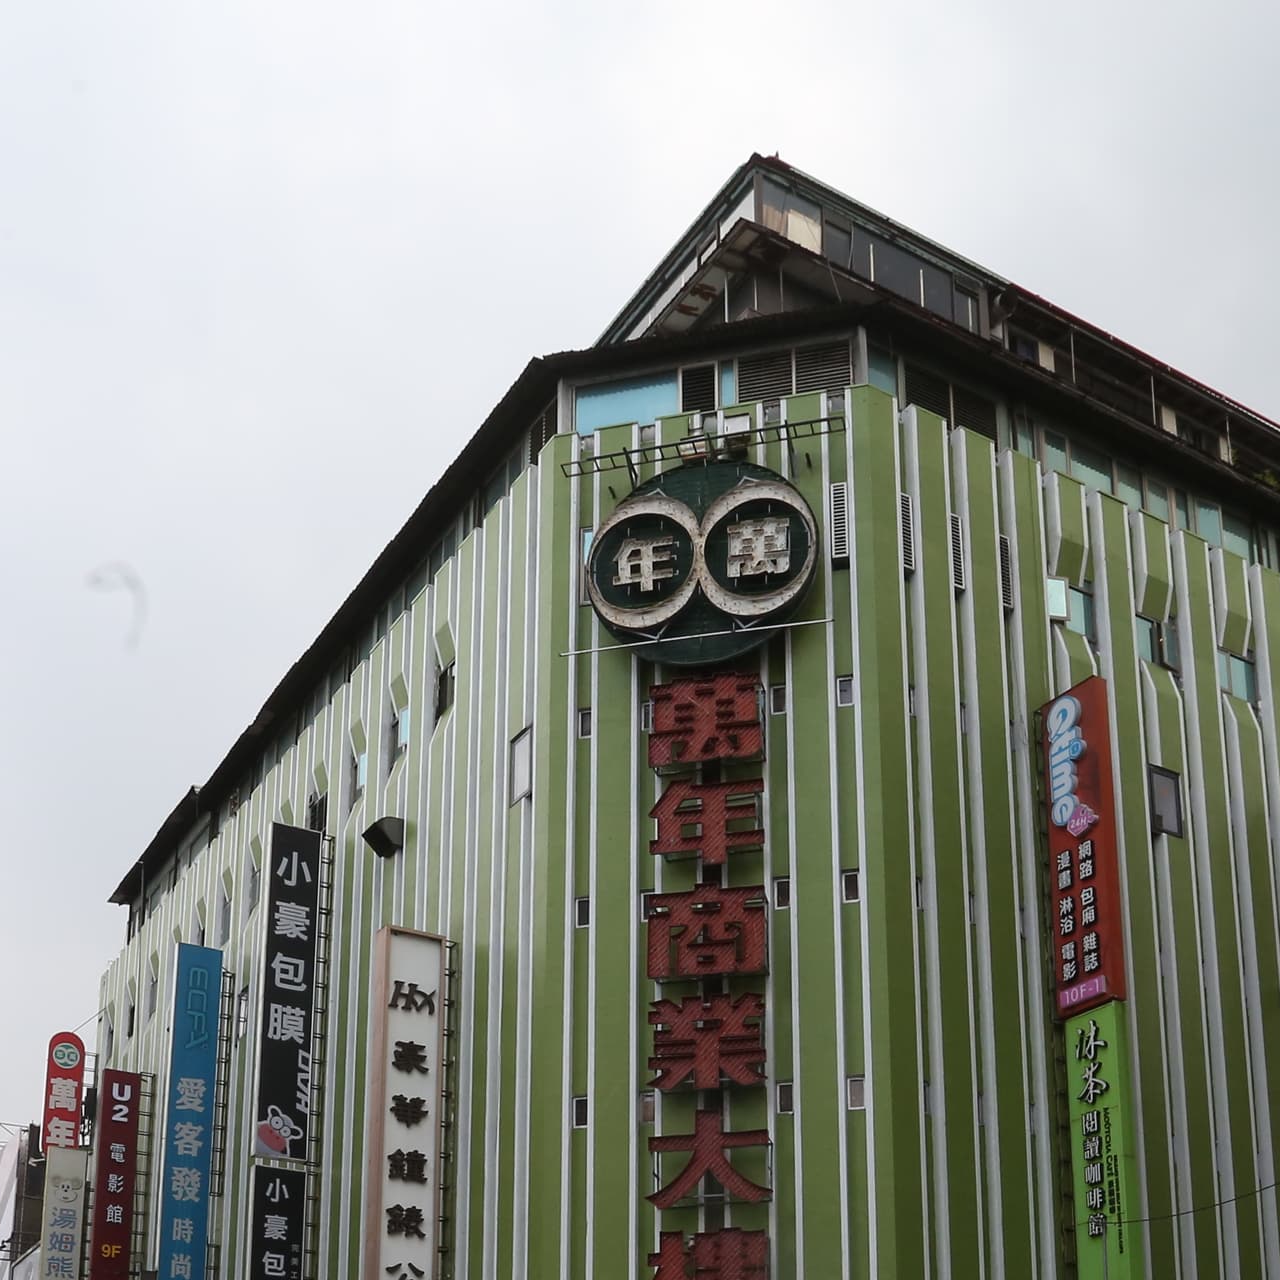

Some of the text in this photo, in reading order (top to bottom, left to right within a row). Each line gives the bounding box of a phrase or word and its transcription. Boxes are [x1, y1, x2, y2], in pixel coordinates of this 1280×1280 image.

[266, 851, 312, 1045] 小豪包膜
[185, 967, 209, 1049] ECFA
[46, 1077, 78, 1147] 萬年
[111, 1081, 132, 1123] U2
[105, 1142, 127, 1225] 電影館
[101, 1243, 123, 1259] 9F
